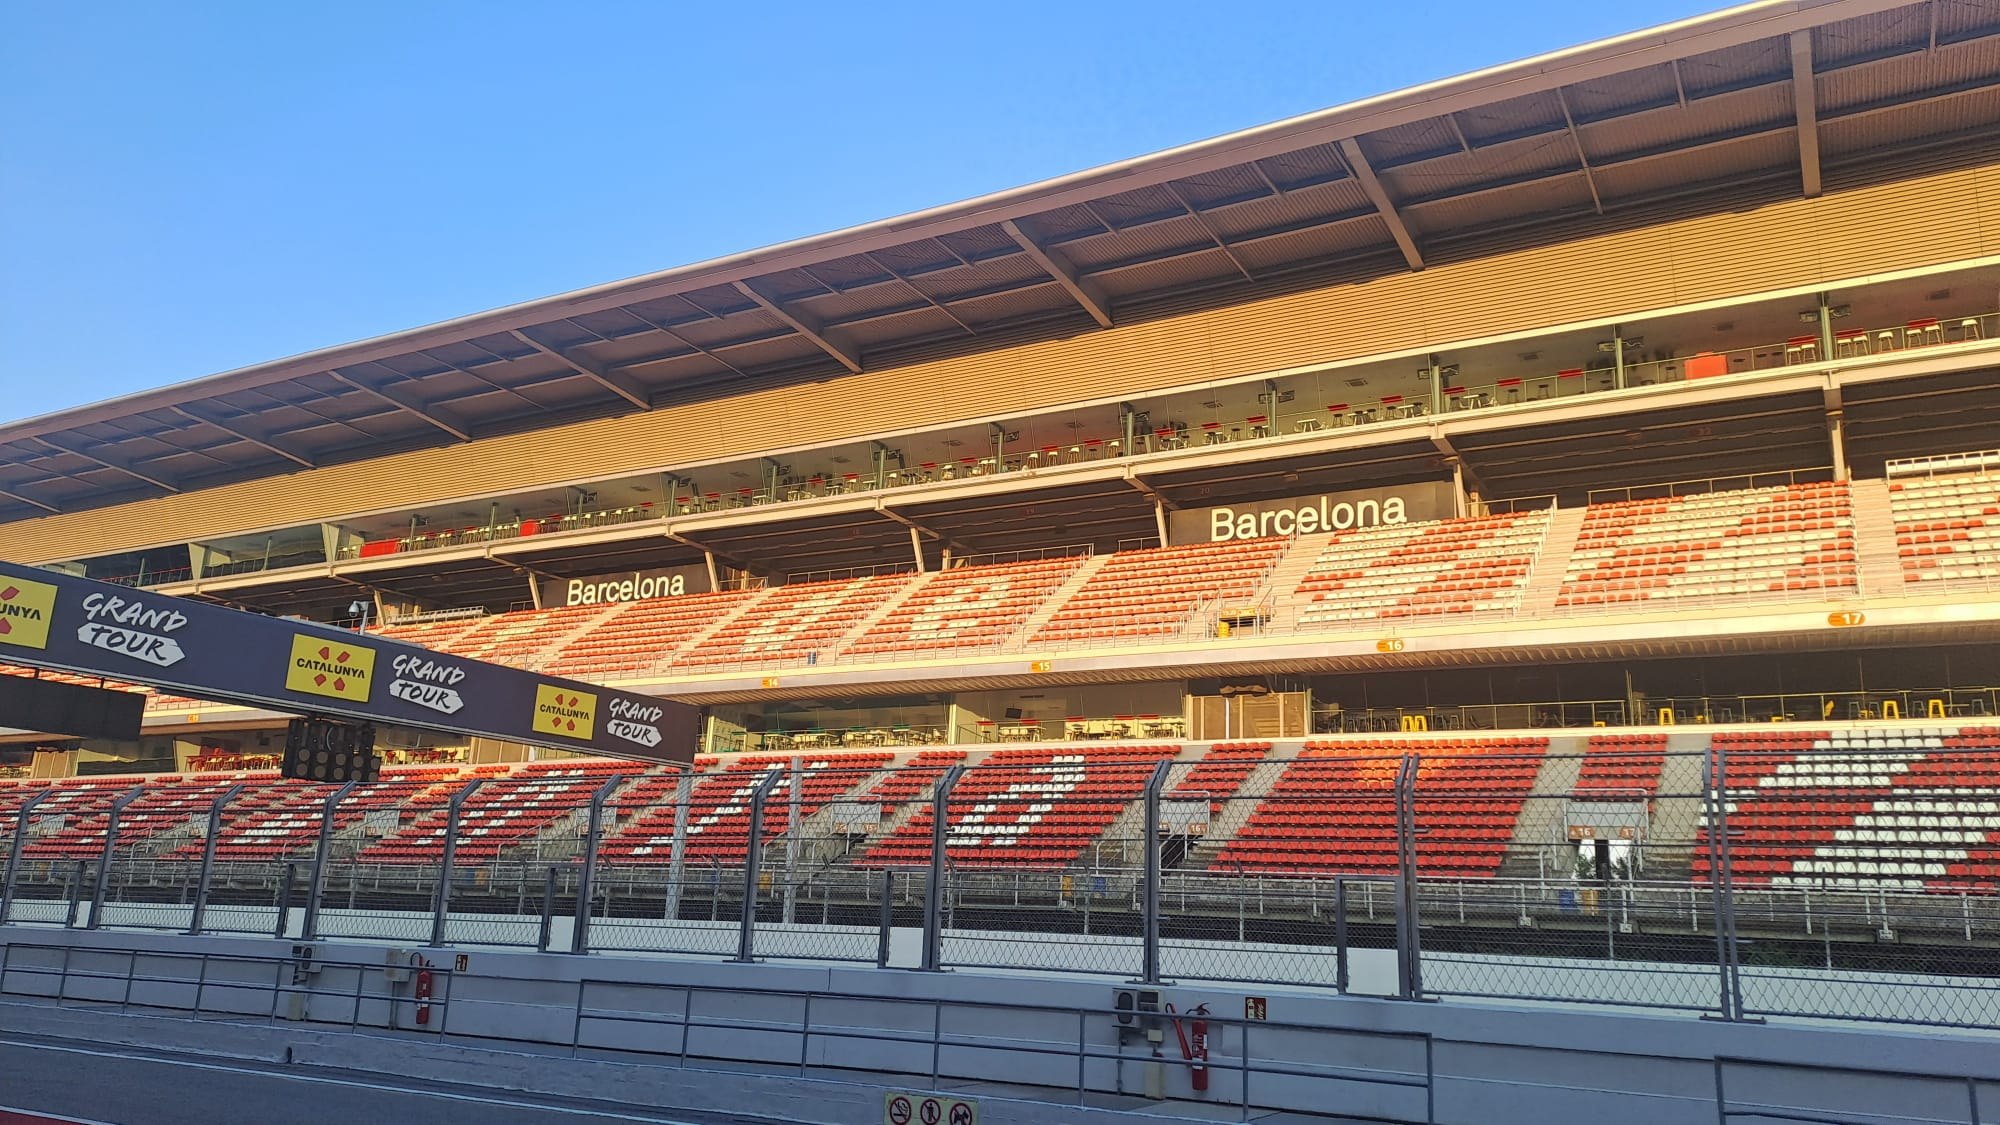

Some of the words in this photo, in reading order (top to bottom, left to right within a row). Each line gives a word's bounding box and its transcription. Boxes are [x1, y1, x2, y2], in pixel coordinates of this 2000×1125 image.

[1211, 495, 1407, 542] Barcelona
[566, 571, 685, 606] Barcelona
[82, 593, 188, 632] GRAND
[1842, 613, 1862, 625] 17
[91, 626, 166, 660] TOUR
[1387, 640, 1402, 651] 16
[296, 657, 365, 679] CATALUNYA
[392, 654, 466, 686] GRAND
[1039, 661, 1050, 671] 15
[398, 681, 451, 709] TOUR
[539, 703, 590, 721] CATALUNYA
[609, 697, 663, 723] GRAND
[613, 721, 652, 743] TOUR
